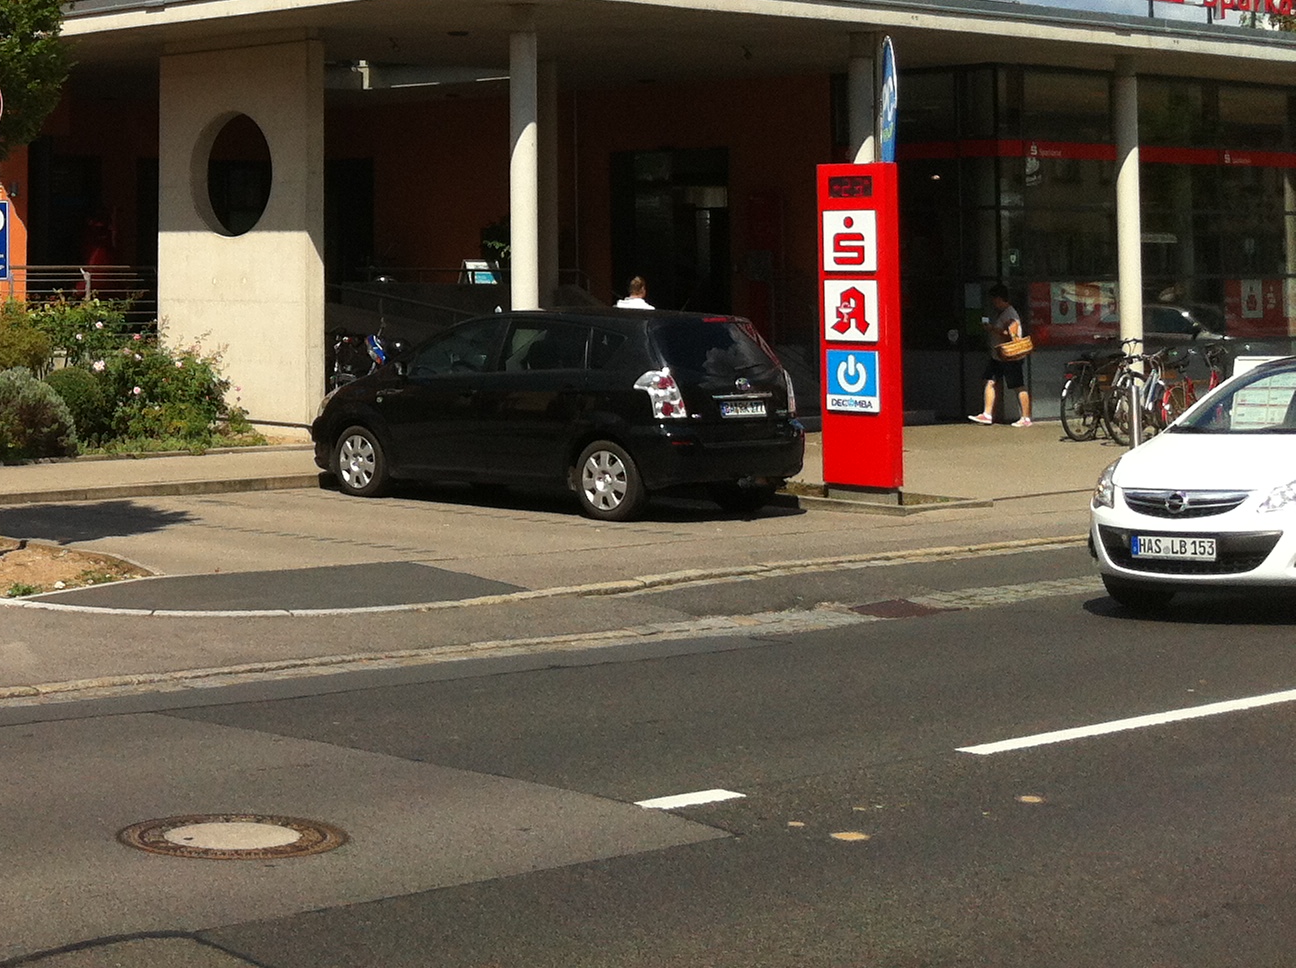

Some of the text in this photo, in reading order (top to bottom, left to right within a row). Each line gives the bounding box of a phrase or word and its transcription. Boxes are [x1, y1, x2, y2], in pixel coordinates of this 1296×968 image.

[832, 216, 865, 266] S
[1138, 538, 1215, 556] HAS LB 153
